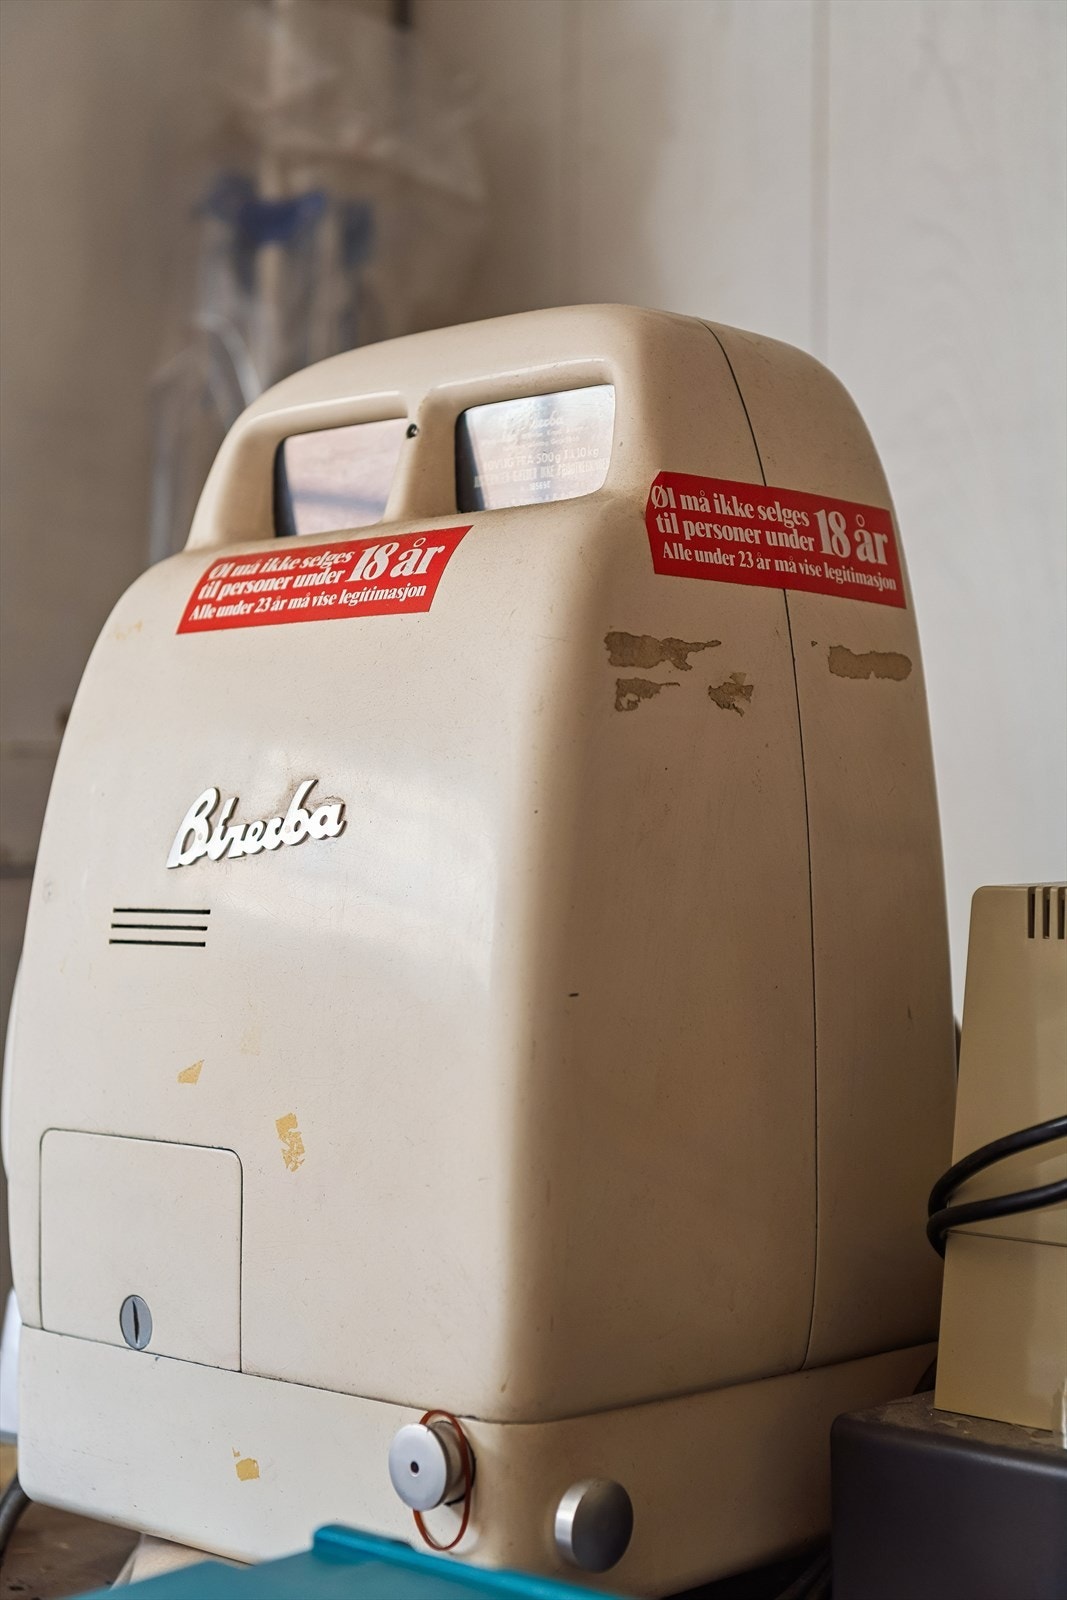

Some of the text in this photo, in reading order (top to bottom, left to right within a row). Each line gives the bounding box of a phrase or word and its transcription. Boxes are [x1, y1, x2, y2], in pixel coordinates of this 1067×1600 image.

[651, 485, 810, 529] Øl må ikke selges
[655, 512, 815, 552] til personer under
[813, 508, 889, 566] 18 år
[209, 551, 354, 580] Øl må ikke selges
[345, 537, 445, 582] 18 år
[662, 541, 897, 592] Alle under 23 år må vise legitimasjon
[188, 582, 428, 621] Alle under 23 år må vise legitimasjon
[197, 565, 346, 600] til personer under
[165, 778, 348, 869] Bizerba
